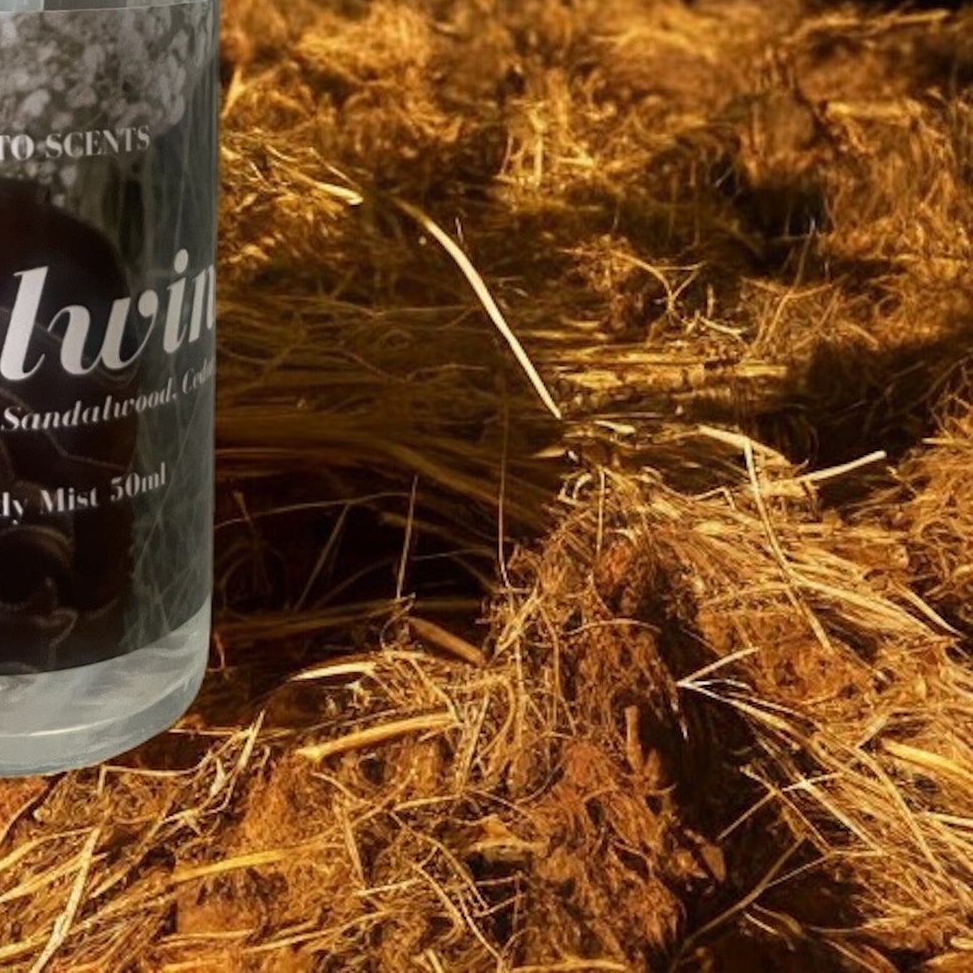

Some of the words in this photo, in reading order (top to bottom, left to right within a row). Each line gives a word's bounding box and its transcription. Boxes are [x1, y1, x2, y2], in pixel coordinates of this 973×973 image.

[45, 126, 151, 159] SCENTS
[39, 486, 99, 515] Mist
[110, 462, 167, 503] 50ml
